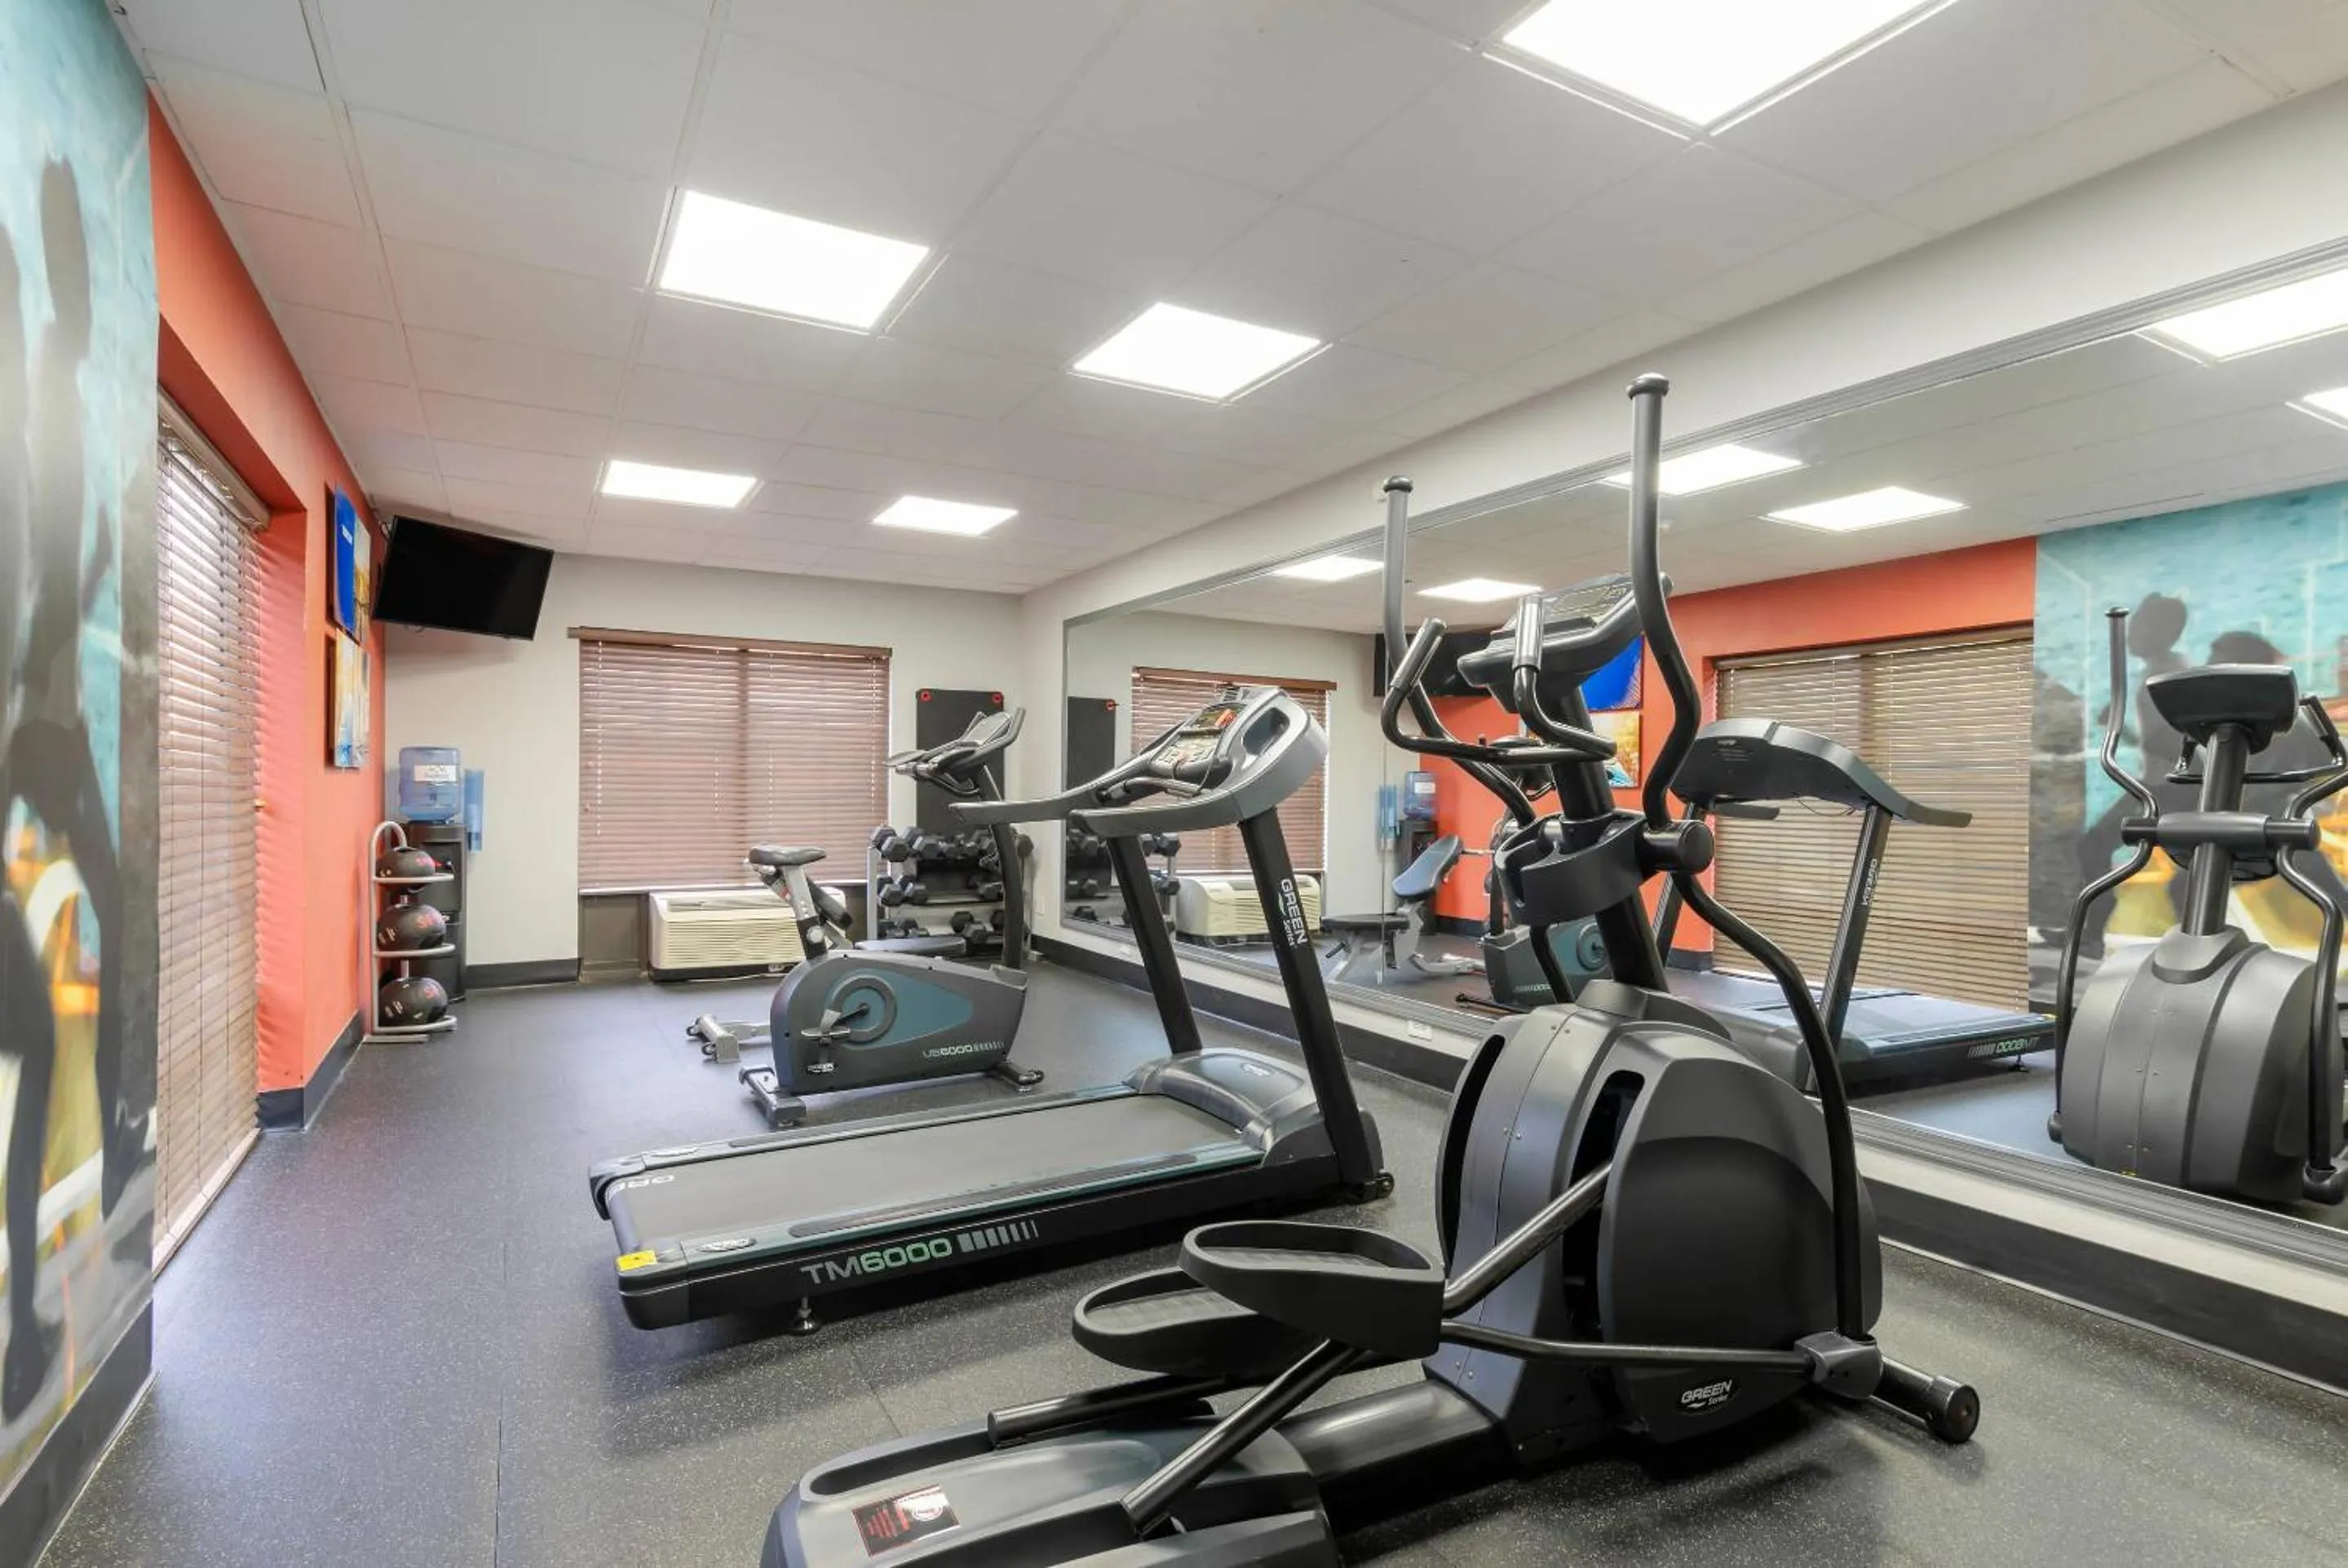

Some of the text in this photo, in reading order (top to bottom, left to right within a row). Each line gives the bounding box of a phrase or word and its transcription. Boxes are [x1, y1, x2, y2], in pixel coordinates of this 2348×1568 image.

[1281, 879, 1307, 944] GREEN
[800, 1238, 952, 1284] TM6000
[1681, 1379, 1732, 1403] GREEN
